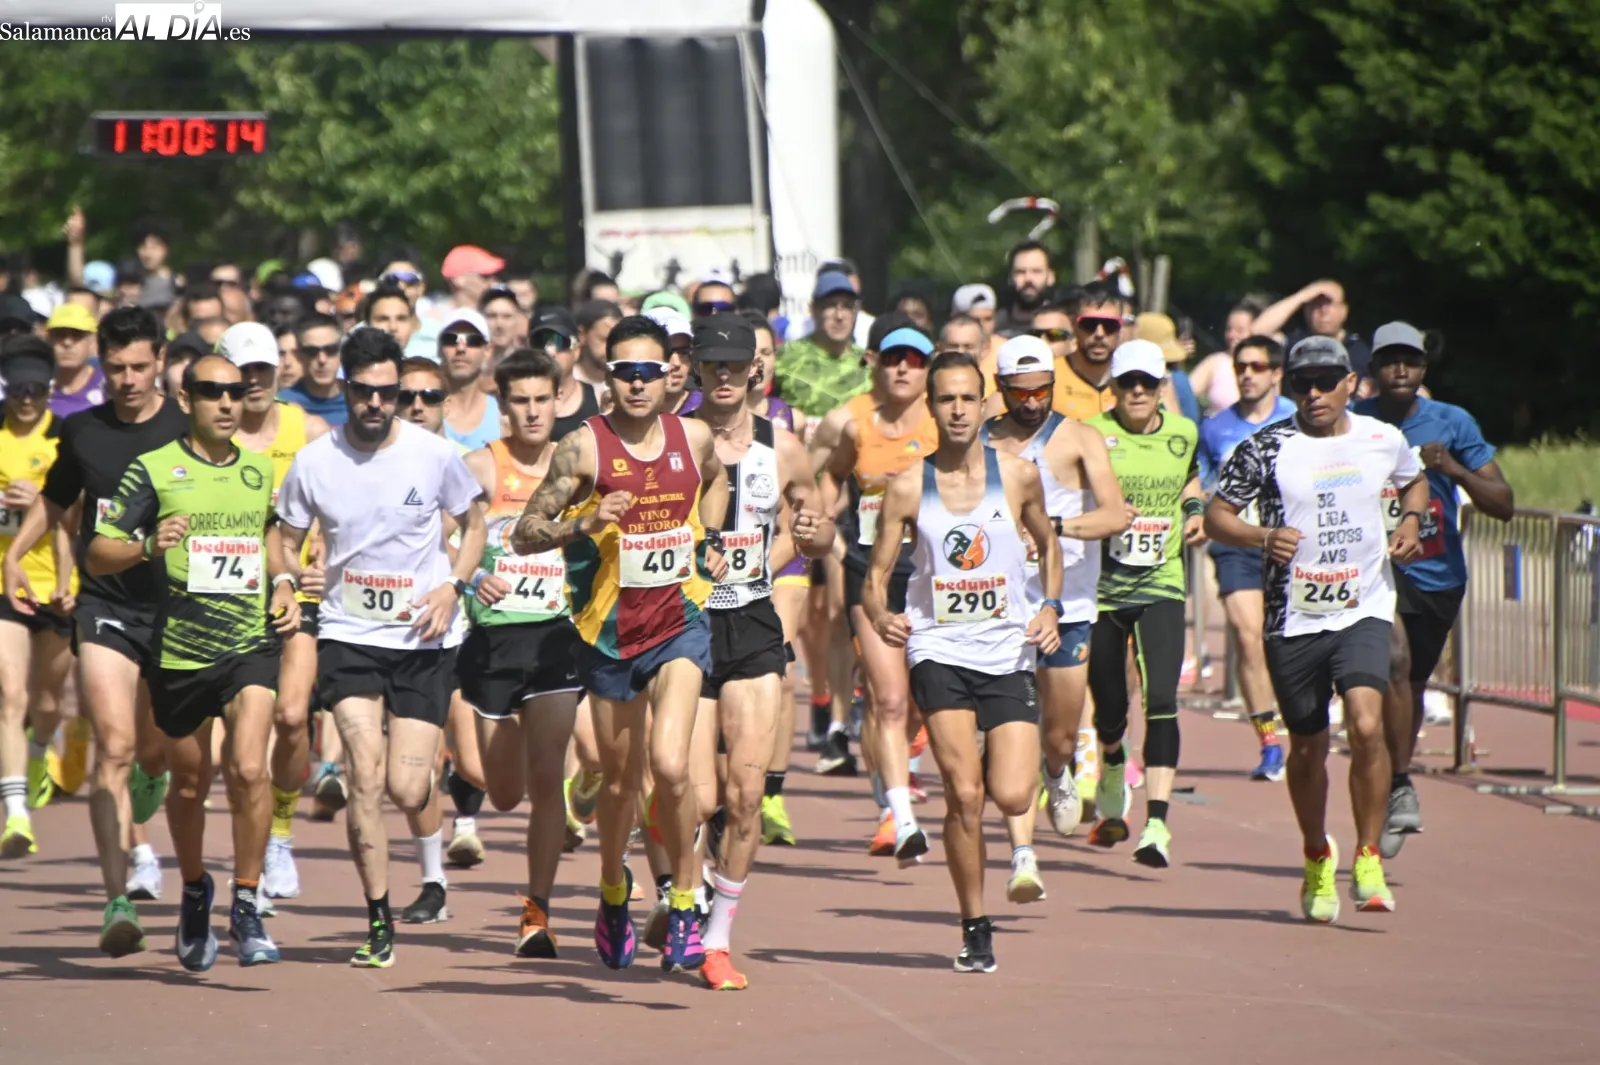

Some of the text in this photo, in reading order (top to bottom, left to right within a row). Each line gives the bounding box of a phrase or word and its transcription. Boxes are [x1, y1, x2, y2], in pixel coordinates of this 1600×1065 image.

[114, 117, 266, 156] 11:00:14
[640, 493, 685, 504] CAJA RURAL
[1317, 492, 1336, 508] 32
[188, 511, 265, 531] ORRECAMINO
[639, 508, 670, 520] VINO
[628, 519, 681, 533] DE TORO
[622, 532, 691, 550] bedunia
[1124, 533, 1163, 553] 155
[1318, 527, 1363, 547] CROSS
[191, 540, 260, 554] bedunia
[1318, 548, 1348, 565] AVS
[211, 556, 244, 579] 74
[497, 559, 563, 577] bedunia
[642, 549, 675, 573] 40
[343, 570, 414, 588] bedunia
[1294, 567, 1360, 583] bedunia
[514, 576, 546, 600] 44
[1304, 582, 1351, 603] 246
[362, 588, 394, 611] 30
[947, 590, 997, 614] 290
